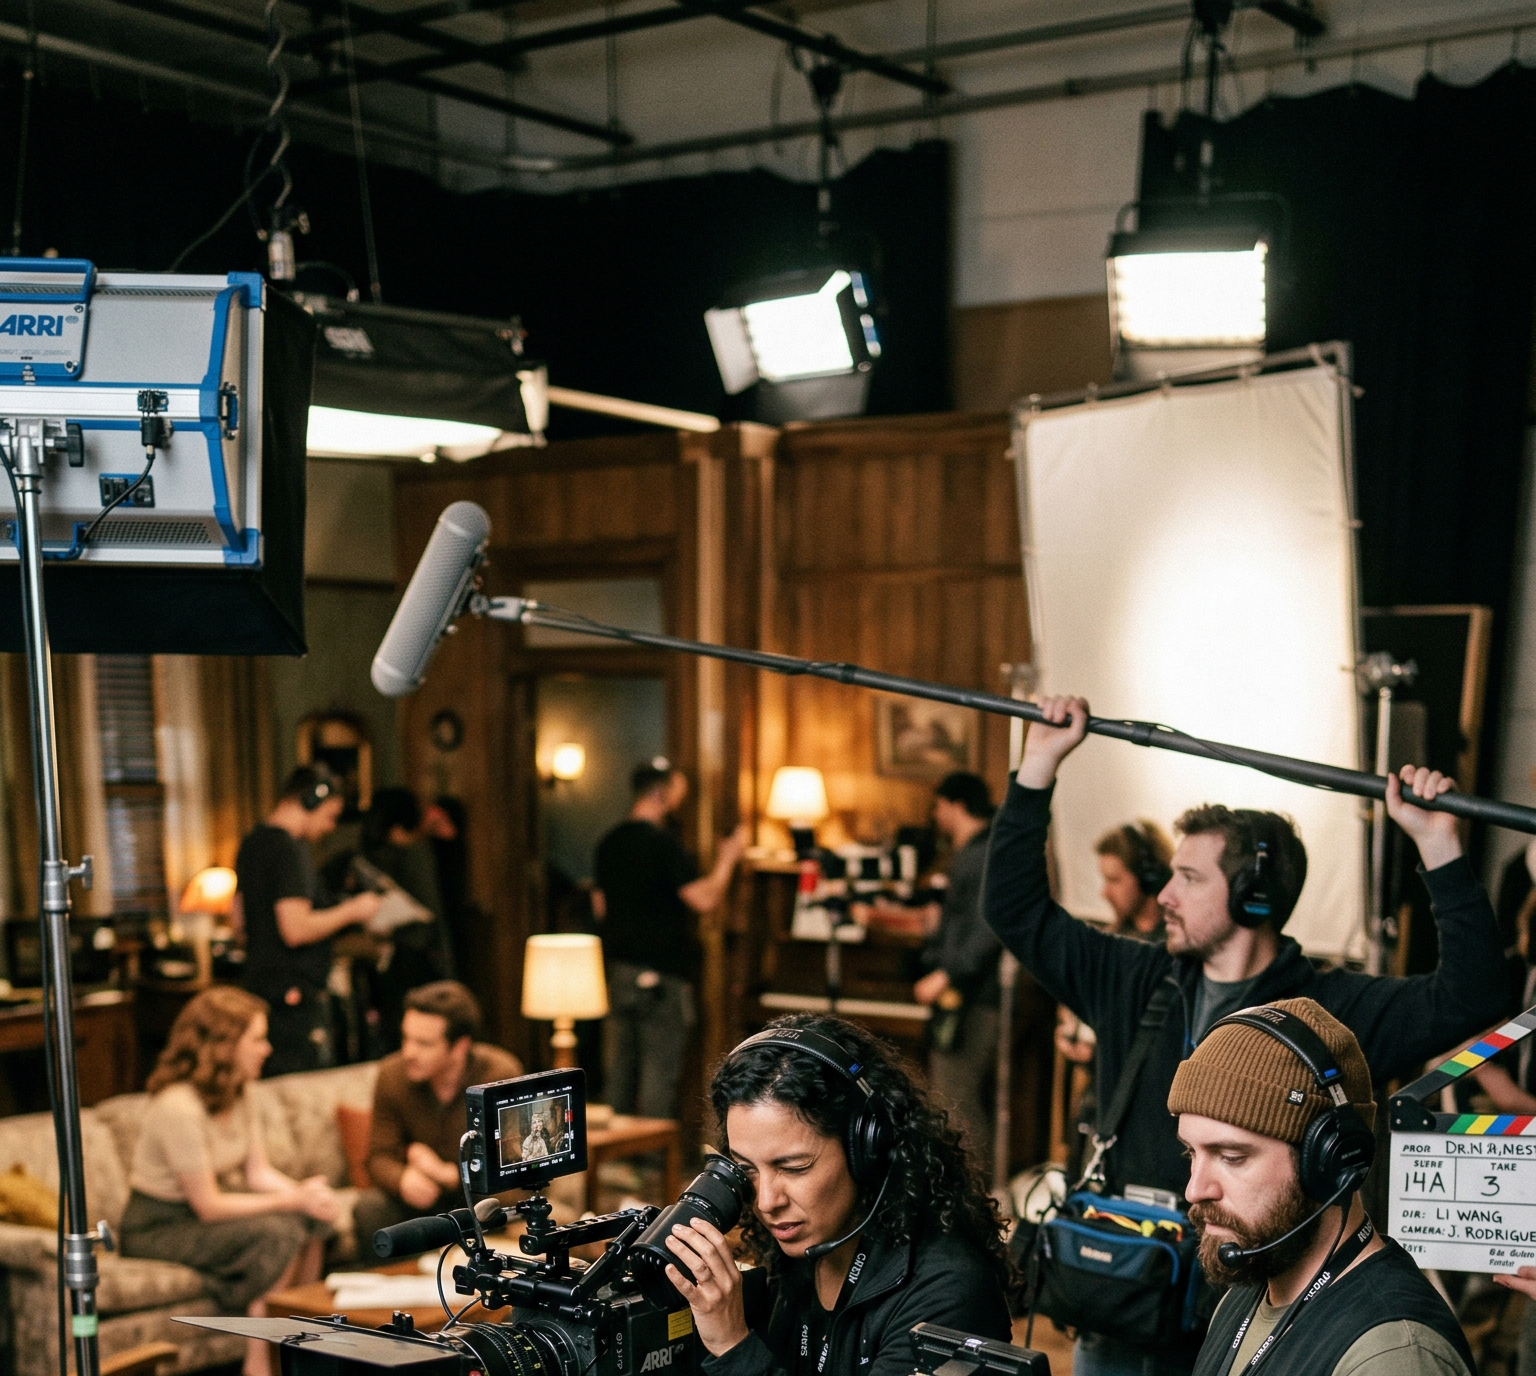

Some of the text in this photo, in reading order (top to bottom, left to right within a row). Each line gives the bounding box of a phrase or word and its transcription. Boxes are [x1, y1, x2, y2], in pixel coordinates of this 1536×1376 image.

[0, 314, 64, 337] ARRI
[1491, 1162, 1517, 1172] TAKE
[1404, 1171, 1500, 1197] 14A 3
[1402, 1207, 1502, 1223] DIR: LI WANG
[1447, 1224, 1460, 1238] J.
[640, 1346, 673, 1373] ARRI
